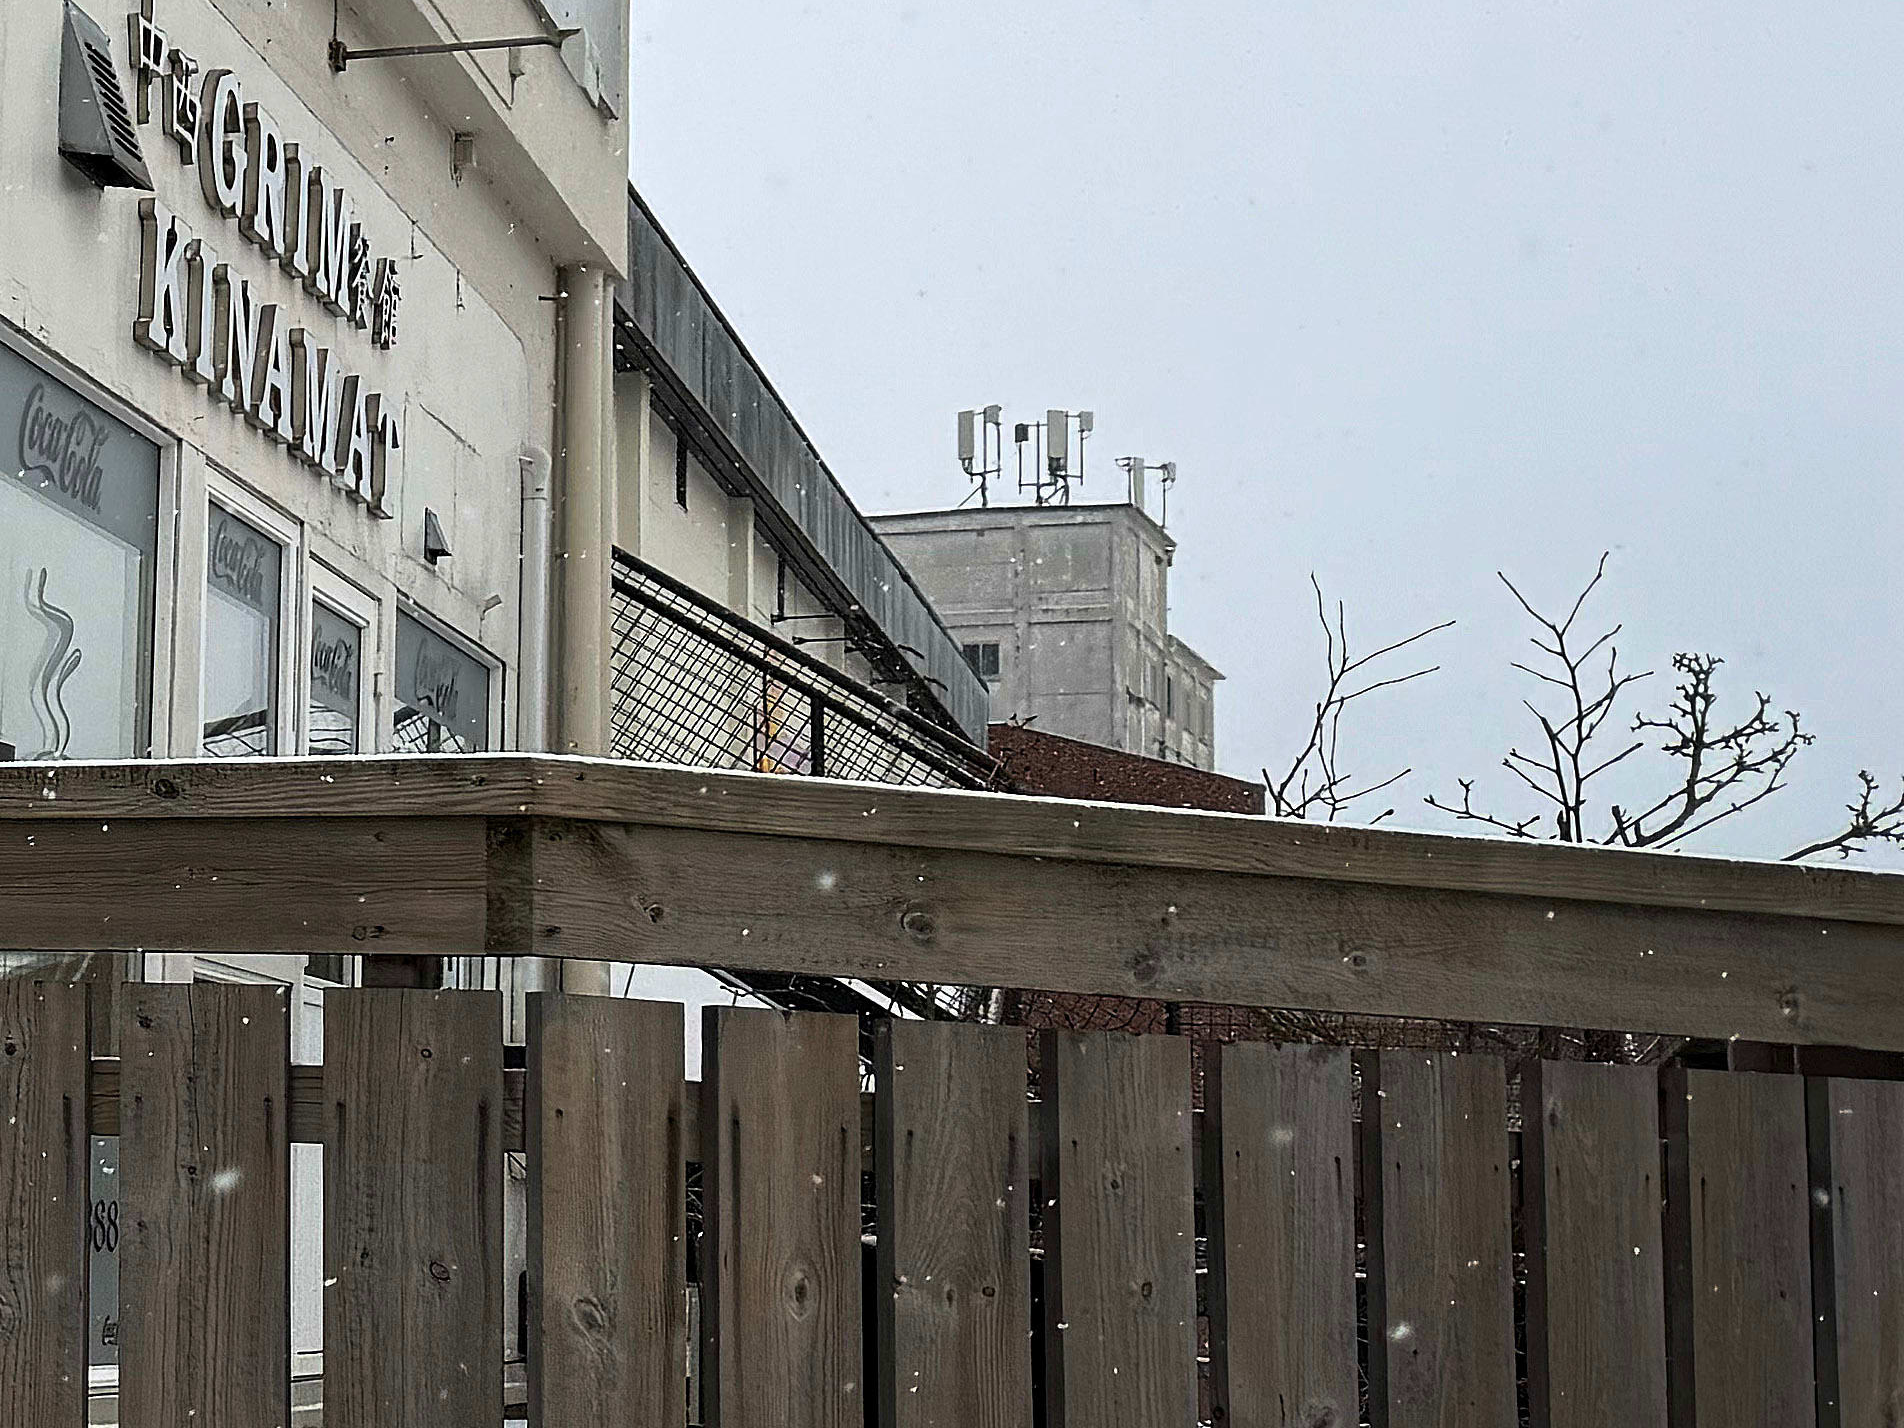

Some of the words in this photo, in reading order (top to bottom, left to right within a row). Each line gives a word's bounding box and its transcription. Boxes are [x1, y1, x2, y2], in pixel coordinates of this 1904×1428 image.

[197, 67, 354, 324] GRIM
[18, 382, 110, 514] Coca-Cola
[132, 196, 400, 520] KINAMAT
